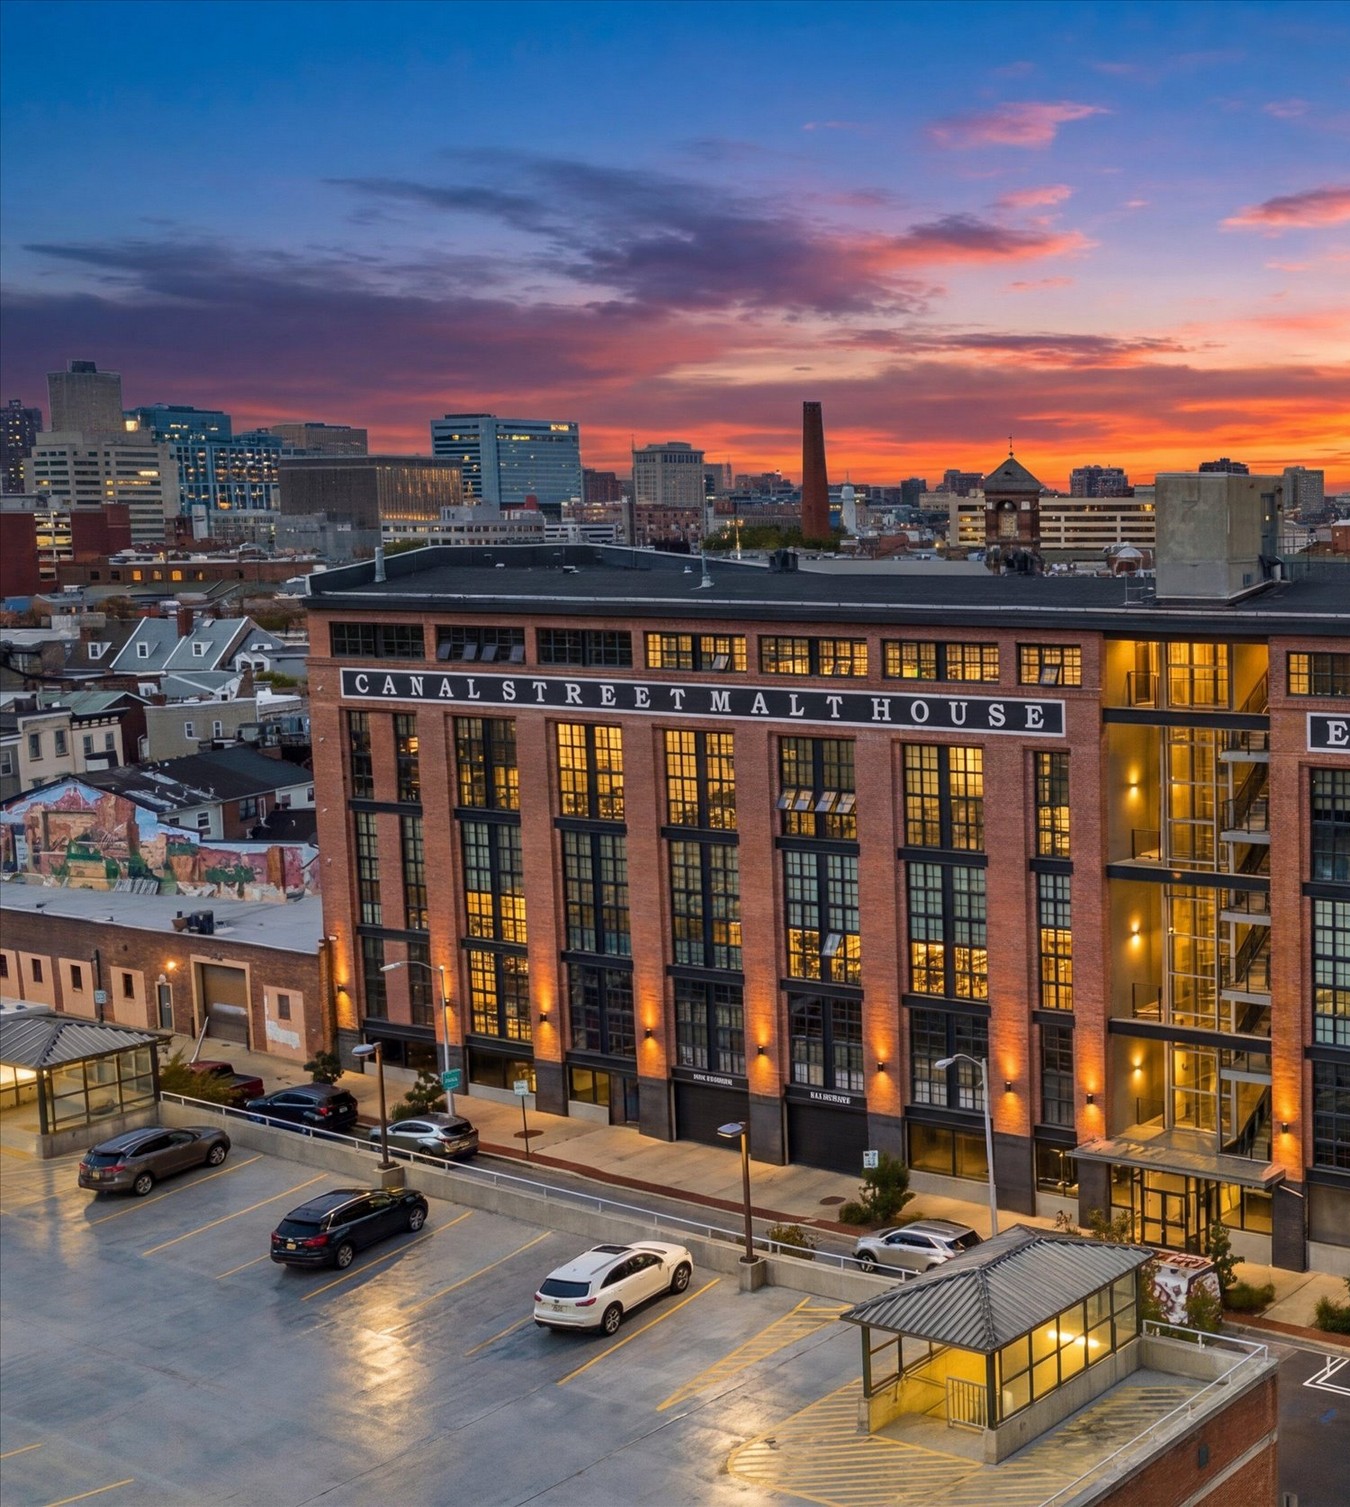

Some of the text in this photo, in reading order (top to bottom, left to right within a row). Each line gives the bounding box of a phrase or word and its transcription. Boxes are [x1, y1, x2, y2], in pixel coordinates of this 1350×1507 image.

[355, 674, 1044, 728] CANAL STREET MALT HOUSE
